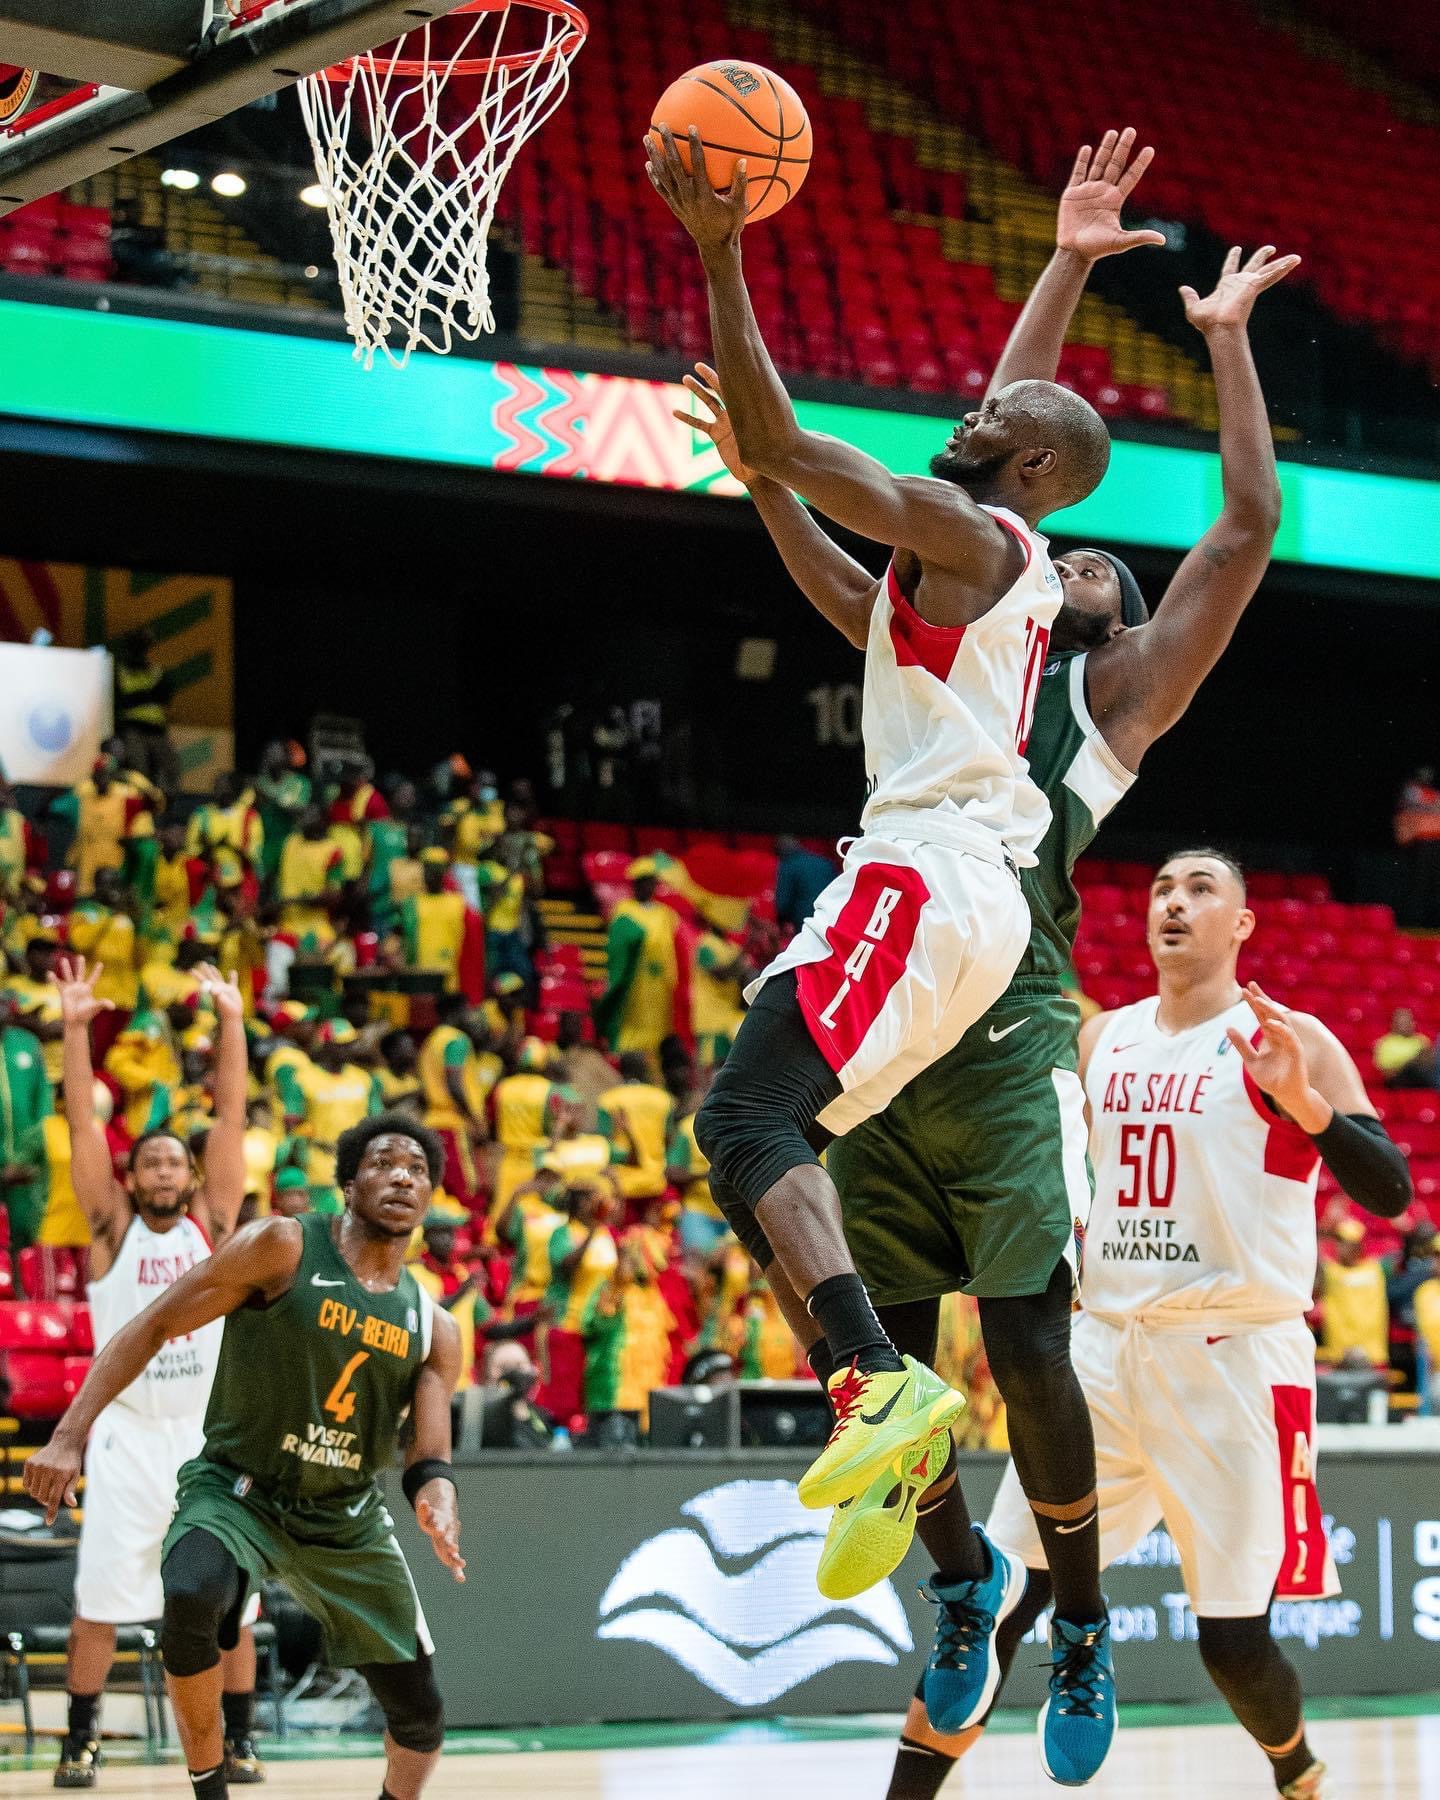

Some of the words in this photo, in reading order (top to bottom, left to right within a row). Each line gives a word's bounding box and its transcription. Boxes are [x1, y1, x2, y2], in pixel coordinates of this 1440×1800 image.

[819, 886, 903, 1031] BAL
[1103, 1072, 1137, 1113] AS
[1141, 1066, 1214, 1115] SALÉ
[1118, 1123, 1177, 1208] 50
[1102, 1241, 1200, 1262] RWANDA
[1117, 1219, 1177, 1239] VISIT
[318, 1298, 410, 1360] CFV-BEIRA
[323, 1350, 371, 1424] 4
[281, 1433, 362, 1471] RWANDA
[307, 1422, 357, 1448] VISIT
